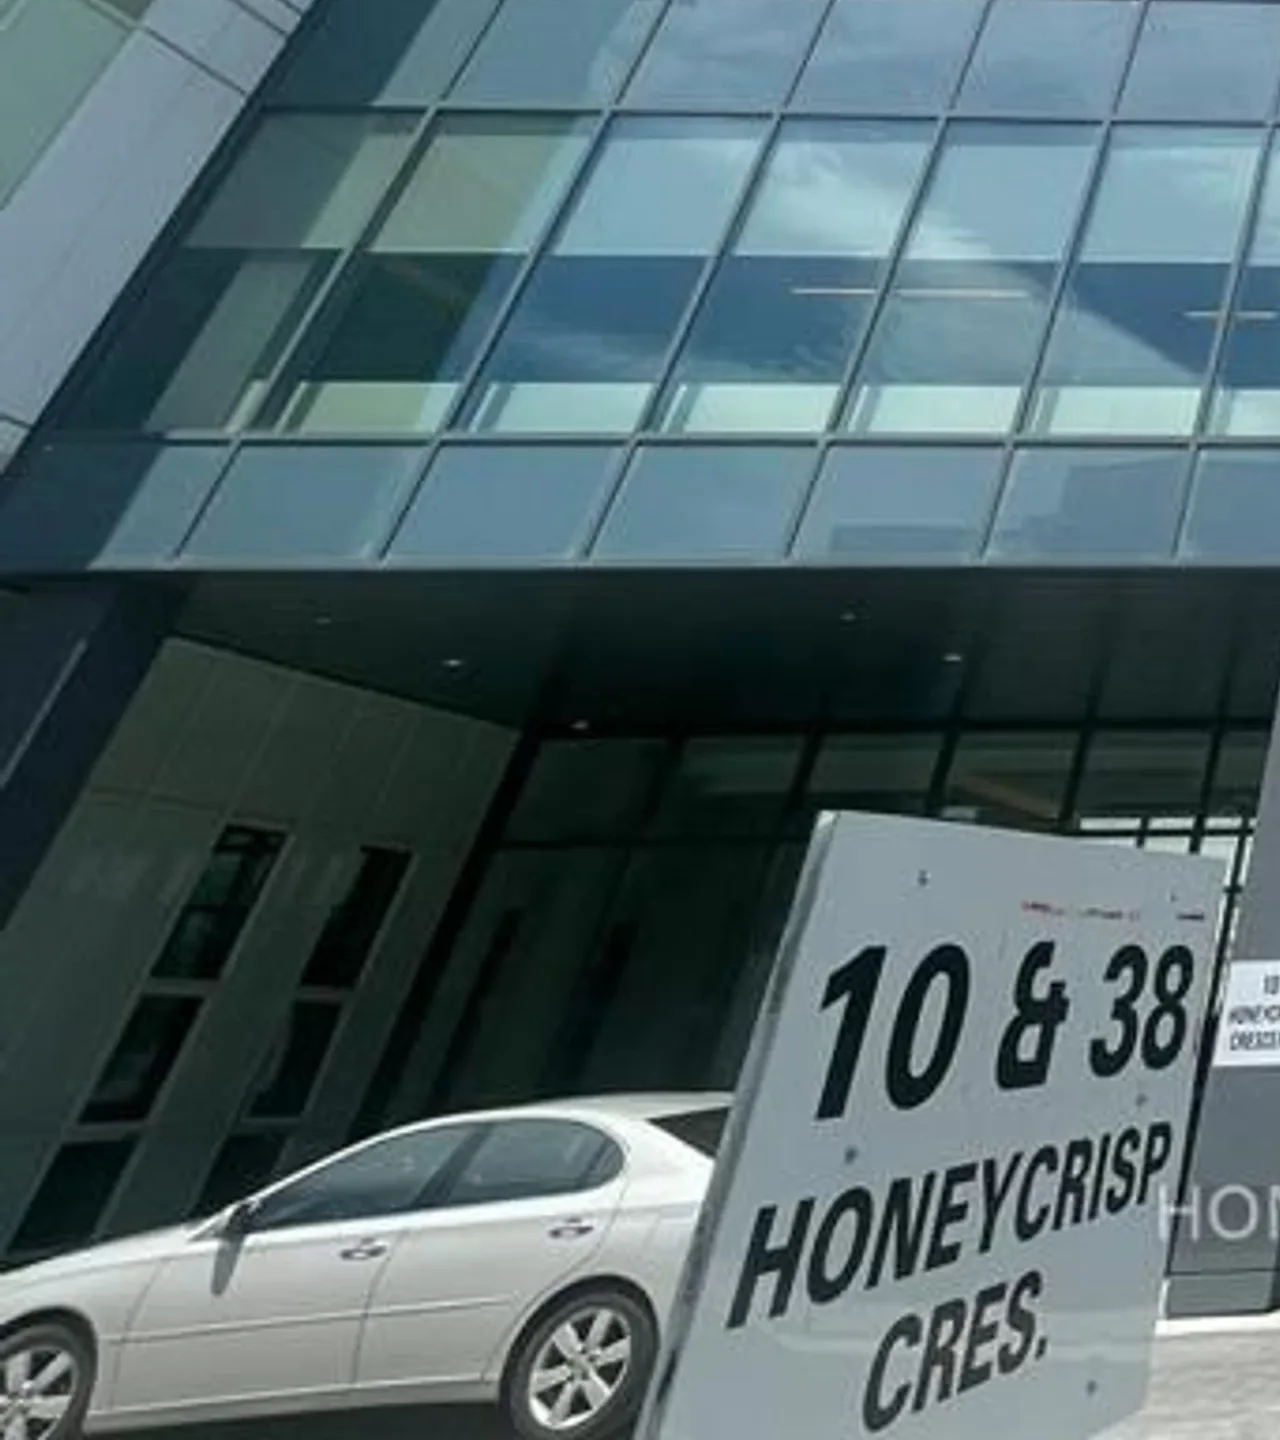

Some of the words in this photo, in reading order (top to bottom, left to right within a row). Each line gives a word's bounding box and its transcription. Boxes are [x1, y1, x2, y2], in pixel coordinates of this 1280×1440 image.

[814, 944, 970, 1120] 10
[997, 940, 1069, 1090] &
[1089, 944, 1194, 1079] 38
[725, 1121, 1172, 1330] HONEYCRISP
[861, 1269, 1048, 1433] CRES.
